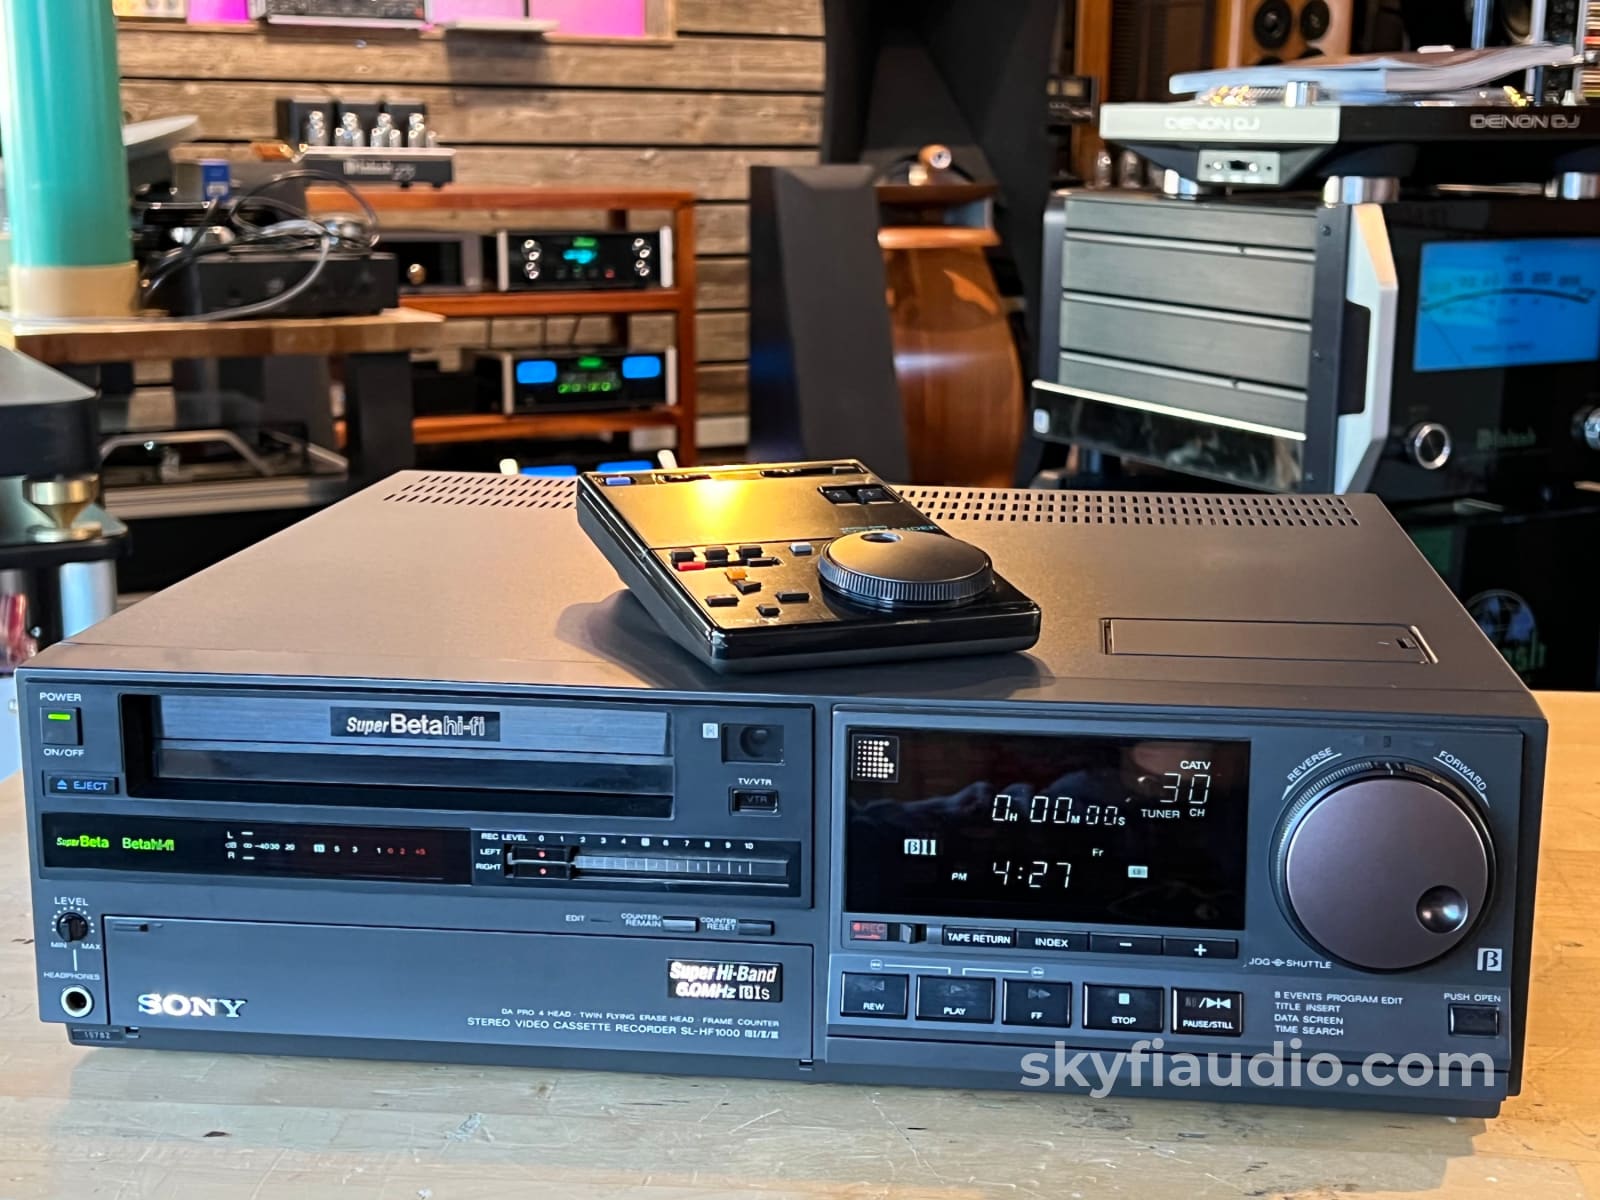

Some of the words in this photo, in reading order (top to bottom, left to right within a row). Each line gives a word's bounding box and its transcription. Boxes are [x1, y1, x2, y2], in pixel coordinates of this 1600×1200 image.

[1164, 117, 1230, 131] DENON
[1233, 118, 1260, 131] DJ
[1470, 114, 1547, 129] DENON
[1551, 114, 1580, 129] DJ
[39, 692, 82, 702] POWER
[43, 748, 84, 757] ON/OFF
[1180, 760, 1212, 770] CATV
[1287, 747, 1333, 782] REVERSE
[1438, 750, 1488, 791] FORWARD
[73, 781, 108, 791] EJECT
[738, 777, 773, 786] TV/VTR
[1160, 772, 1212, 804] 30
[1141, 808, 1181, 819] TUNER
[1189, 808, 1206, 817] CH
[481, 833, 499, 841] REC
[502, 834, 528, 842] LEVEL
[480, 848, 501, 856] LEFT
[476, 863, 502, 871] RIGHT
[951, 873, 967, 881] PM
[993, 861, 1072, 888] 4:27
[54, 896, 89, 906] LEVEL
[565, 914, 585, 922] EDIT
[700, 917, 737, 925] COUNTER
[625, 919, 662, 928] REMAIN
[706, 923, 736, 931] RESET
[948, 933, 970, 942] TAPE
[972, 934, 1011, 944] RETURN
[1035, 938, 1068, 948] INDEX
[81, 943, 101, 951] MAX
[1249, 958, 1270, 967] JOG
[1286, 959, 1332, 969] SHUTTLE
[43, 971, 100, 981] HEADPHONES
[669, 962, 716, 981] Super
[716, 965, 777, 983] Hi-Band
[1283, 992, 1322, 1001] EVENTS
[1326, 994, 1378, 1004] PROGRAM
[1381, 996, 1403, 1005] EDIT
[1443, 992, 1470, 1001] PUSH
[1474, 993, 1502, 1002] OPEN
[138, 994, 246, 1018] SONY
[863, 1002, 884, 1010] REW
[943, 1006, 966, 1016] PLAY
[1275, 1002, 1300, 1011] TITLE
[1306, 1003, 1341, 1013] INSERT
[547, 1010, 572, 1018] HEAD
[580, 1011, 603, 1019] TWIN
[670, 1015, 694, 1023] HEAD
[702, 1017, 733, 1025] FRAME
[737, 1018, 780, 1027] COUNTER
[1031, 1011, 1043, 1019] FF
[1274, 1014, 1299, 1023] DATA
[1302, 1015, 1344, 1025] SCREEN
[467, 1017, 511, 1027] STEREO
[515, 1019, 550, 1029] VIDEO
[553, 1021, 611, 1031] CASSETTE
[615, 1024, 677, 1034] RECORDER
[1111, 1016, 1137, 1025] STOP
[1182, 1020, 1234, 1030] PAUSE/STILL
[1275, 1025, 1299, 1034] TIME
[1302, 1026, 1344, 1036] SEARCH
